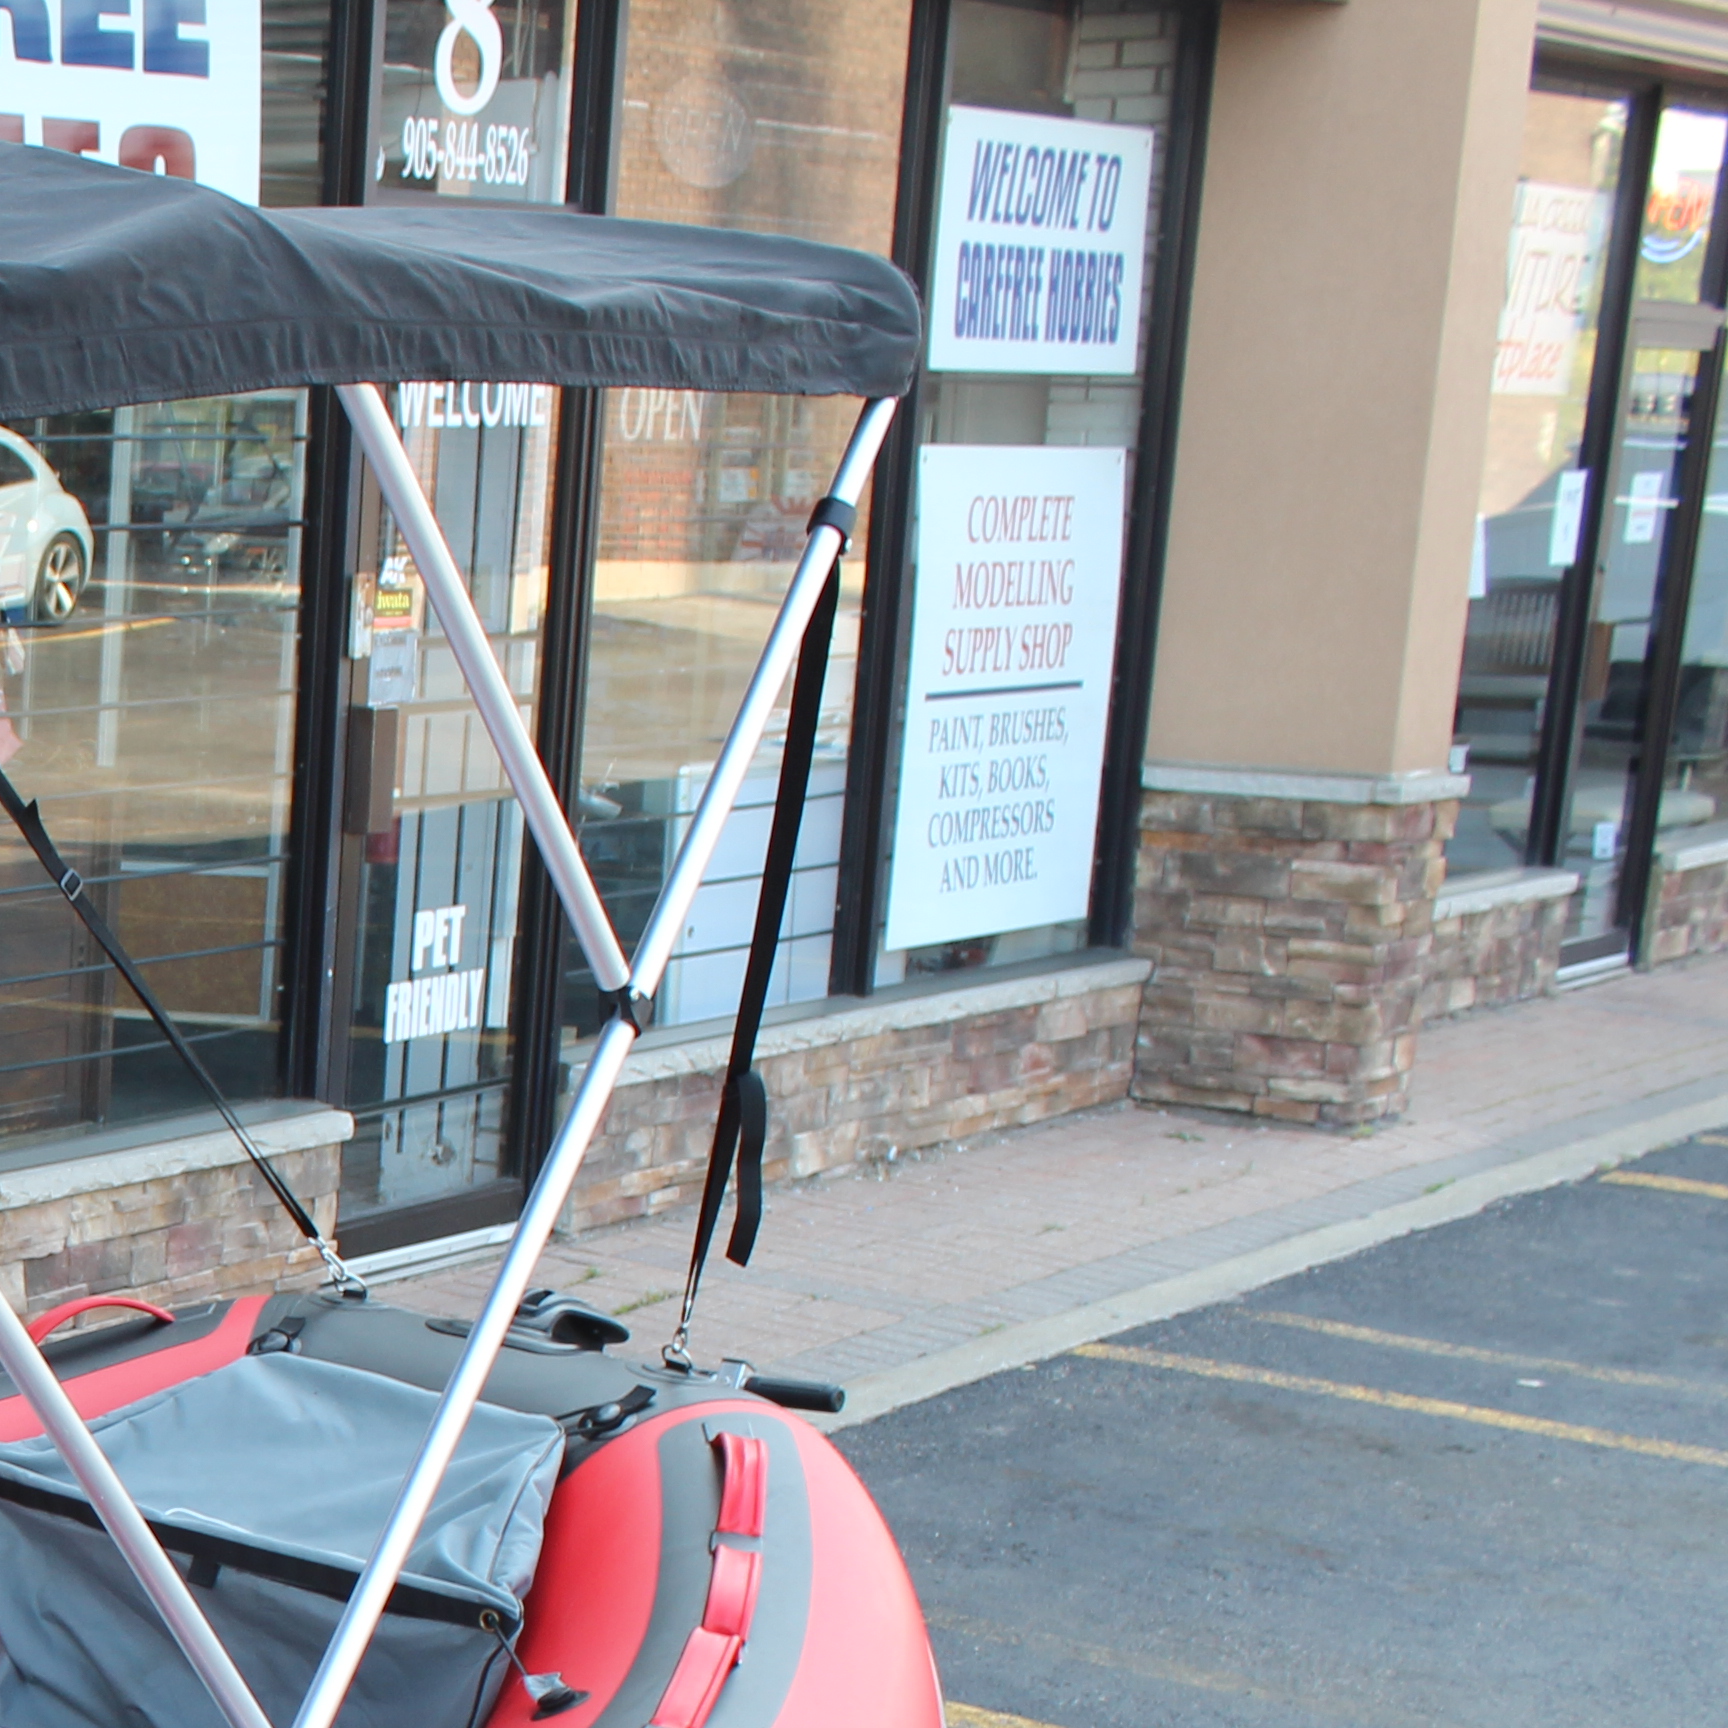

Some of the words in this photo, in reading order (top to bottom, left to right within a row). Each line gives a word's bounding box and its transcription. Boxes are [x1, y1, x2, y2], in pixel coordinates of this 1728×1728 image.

[402, 116, 530, 186] 905-844-8526
[967, 139, 1091, 230] WELCOME
[1086, 152, 1123, 233] TO
[954, 240, 1046, 342] CAREFREE
[1044, 247, 1125, 346] HOBBIES
[398, 381, 545, 429] WELCOME
[619, 388, 705, 441] OPEN
[967, 495, 1075, 544] COMPLETE
[376, 590, 410, 610] iwata
[952, 558, 1076, 610] MODELLING
[942, 625, 1018, 676] SUPPLY
[1018, 622, 1073, 672] SHOP
[928, 714, 984, 753] PAINT,
[988, 705, 1069, 747] BRUSHES,
[938, 761, 983, 800] KITS,
[987, 754, 1050, 794] BOOKS,
[927, 798, 1055, 849] COMPRESSORS
[940, 854, 980, 894] AND
[983, 847, 1038, 887] MORE.
[411, 904, 467, 972] PET
[383, 967, 485, 1045] FRIENDLY
